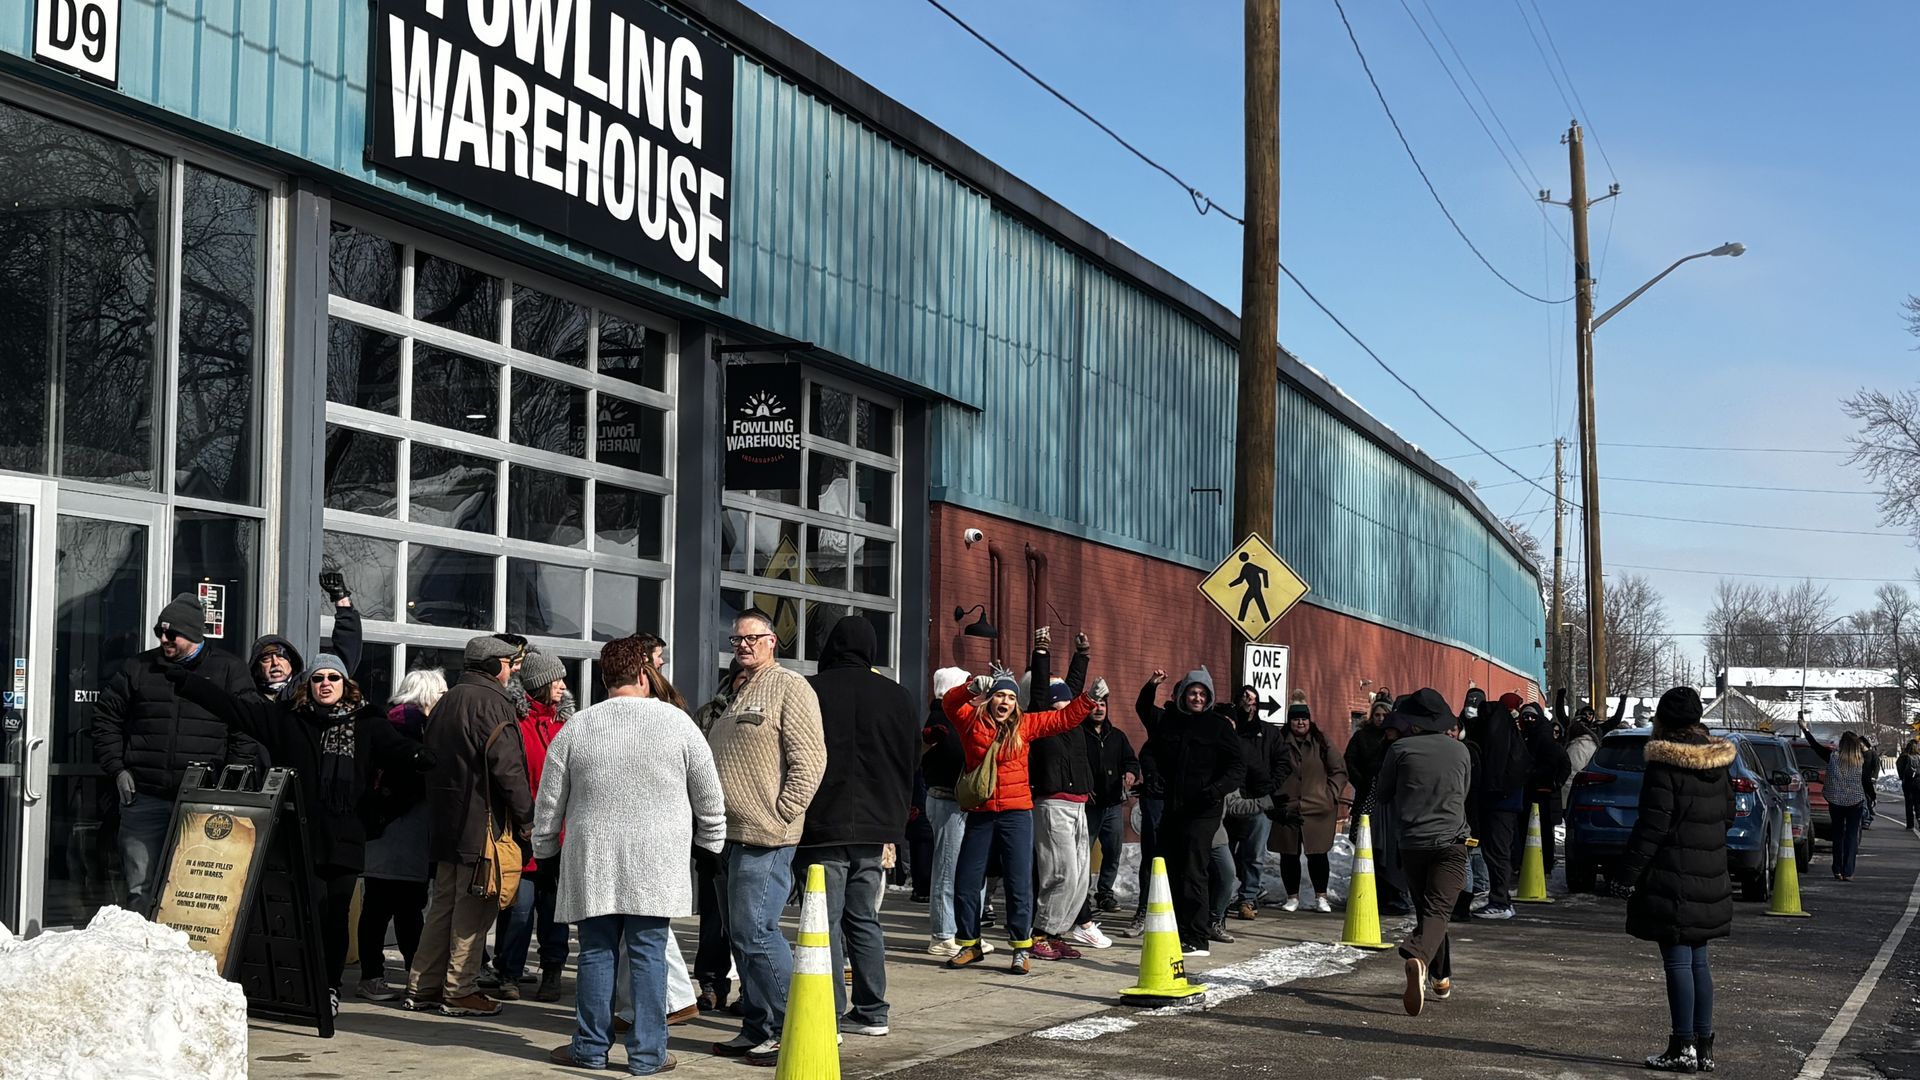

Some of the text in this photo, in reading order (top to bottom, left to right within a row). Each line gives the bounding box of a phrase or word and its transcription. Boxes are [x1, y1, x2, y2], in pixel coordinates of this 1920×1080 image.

[48, 0, 107, 63] D9
[389, 13, 725, 289] WAREHOUSE
[732, 418, 794, 434] FOWLING
[726, 433, 801, 451] WAREHOUSE
[1252, 649, 1281, 668] ONE
[1252, 671, 1282, 690] WAY
[74, 689, 101, 702] EXIT
[215, 862, 234, 871] FILLED
[175, 890, 228, 903] LOCALS GATHER FOR
[176, 900, 196, 908] DRINKS
[195, 901, 208, 909] AND
[193, 925, 220, 936] FOOTBALL
